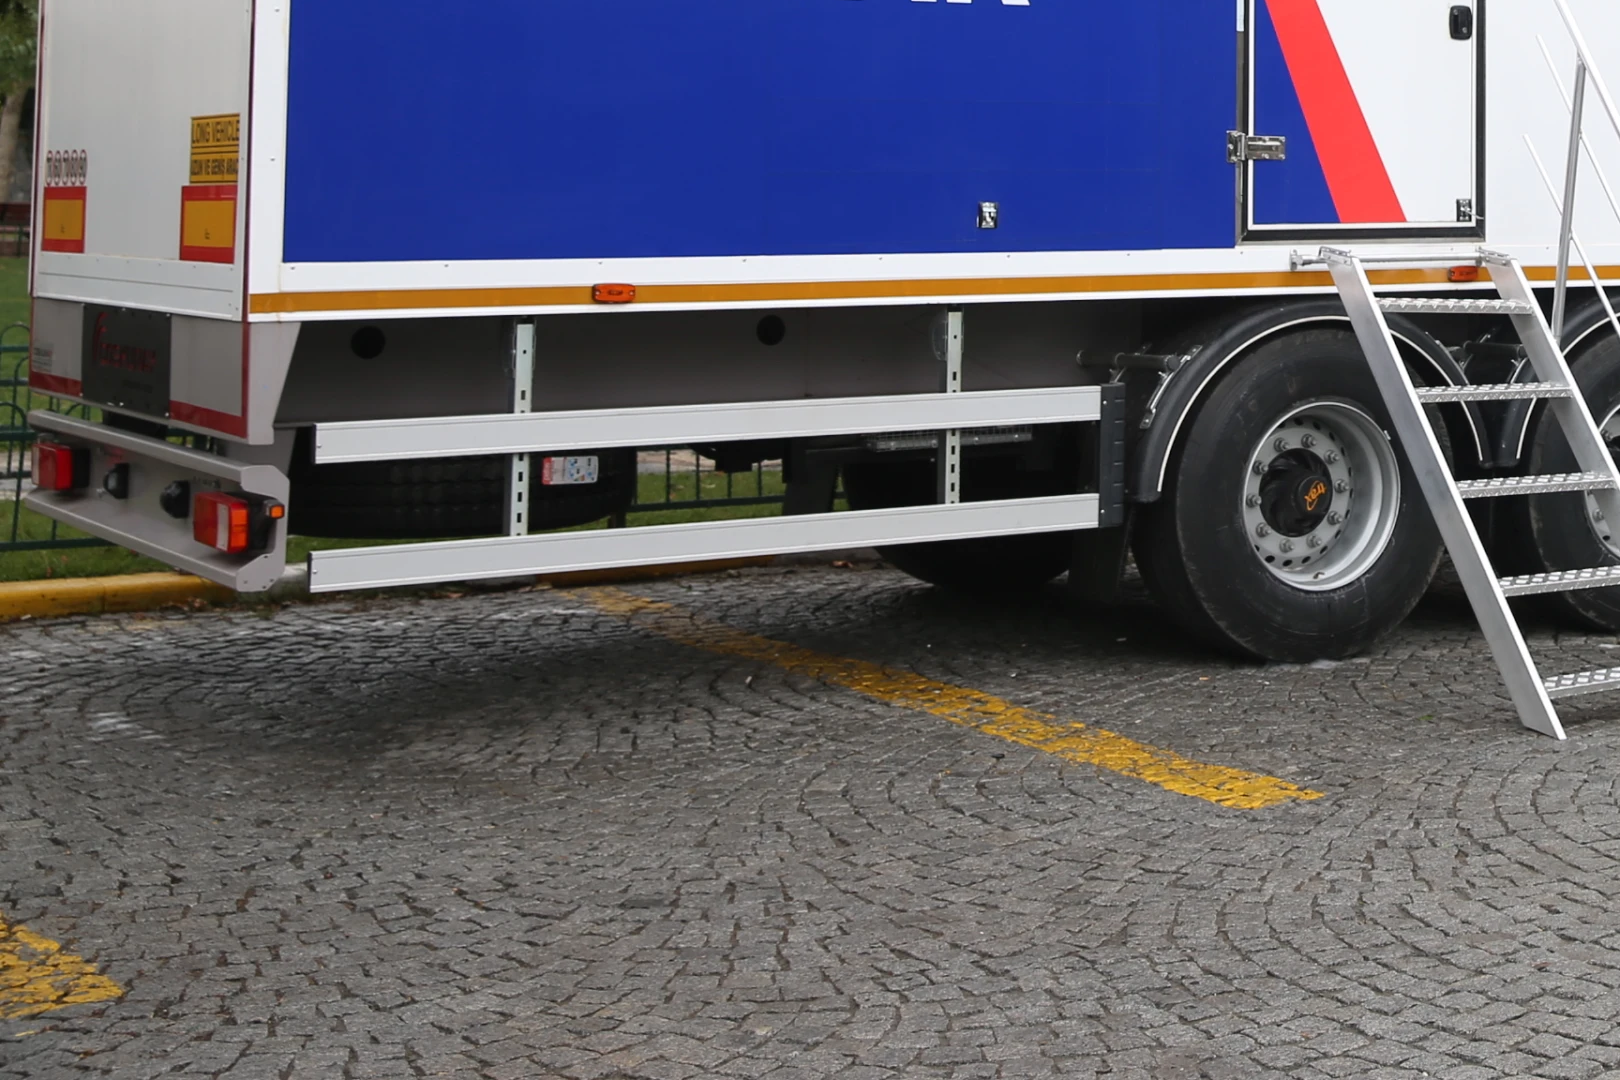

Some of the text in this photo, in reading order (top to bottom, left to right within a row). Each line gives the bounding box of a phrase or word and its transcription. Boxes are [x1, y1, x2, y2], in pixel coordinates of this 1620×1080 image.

[192, 119, 240, 143] LONG VEHICLE
[1303, 481, 1327, 503] trax
